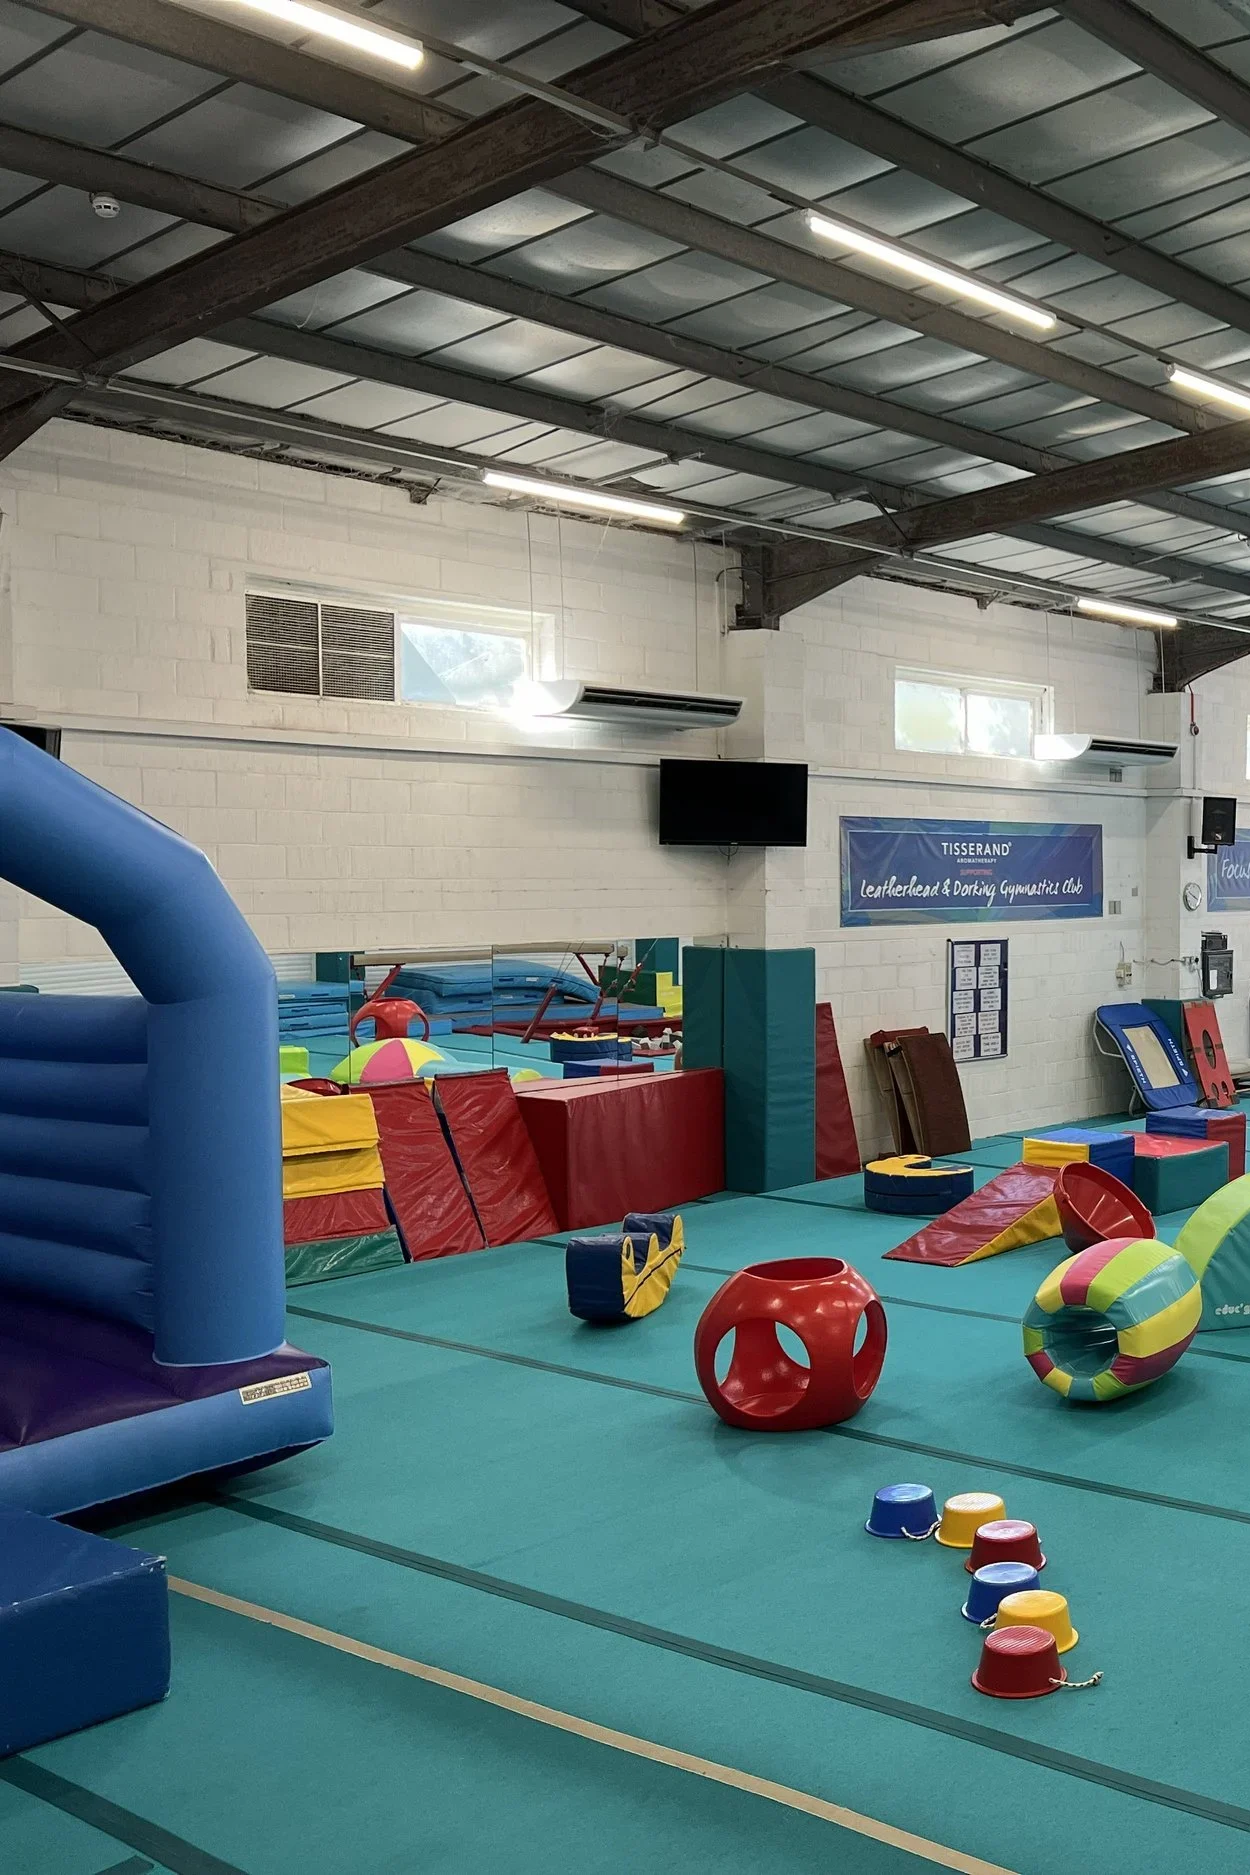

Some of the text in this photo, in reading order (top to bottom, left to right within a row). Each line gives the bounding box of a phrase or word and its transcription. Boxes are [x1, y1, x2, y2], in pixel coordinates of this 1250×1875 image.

[860, 875, 1083, 907] Leatherhead & Dorking Gymnastics Club
[1168, 1038, 1184, 1066] SPIETH
[1130, 1054, 1147, 1084] SPIETH
